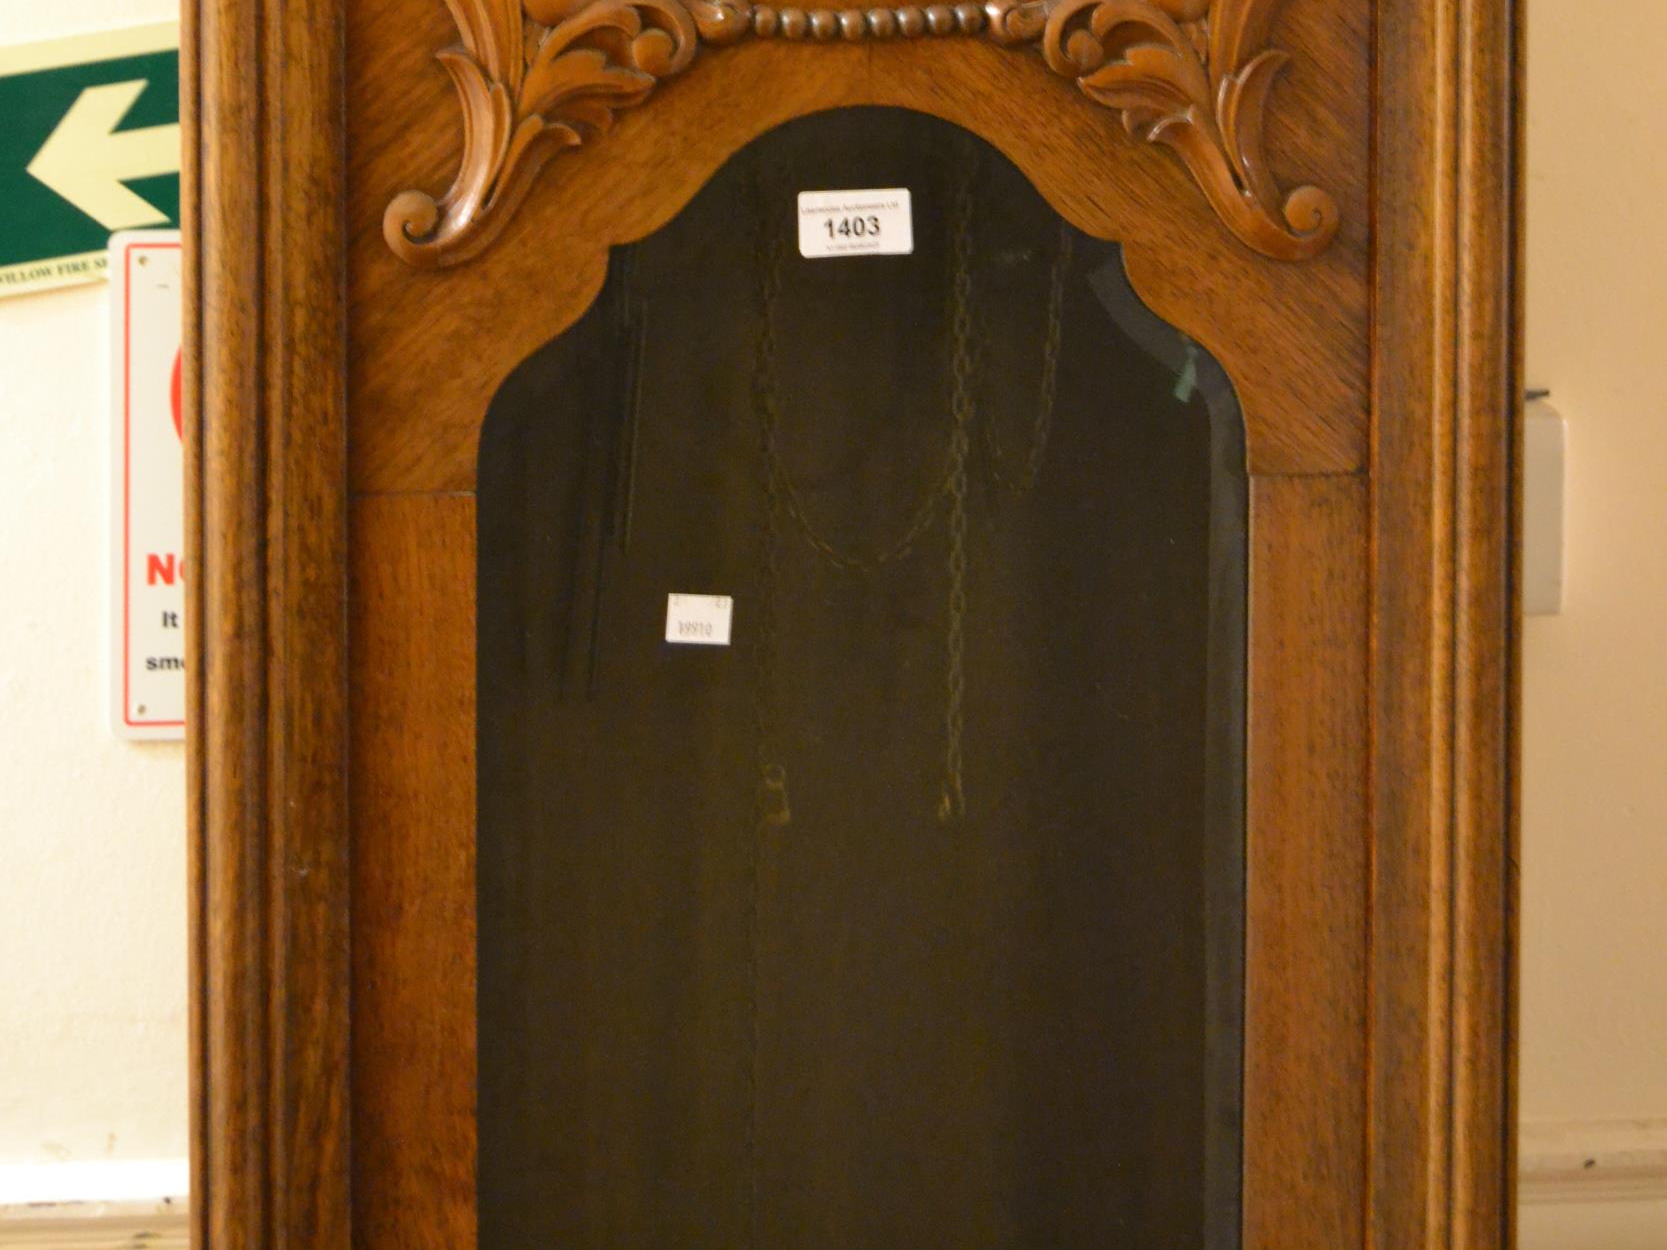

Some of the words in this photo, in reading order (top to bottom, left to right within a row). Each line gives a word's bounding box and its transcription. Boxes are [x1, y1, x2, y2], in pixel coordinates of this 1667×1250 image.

[823, 216, 880, 238] 1403
[57, 261, 88, 275] FIRE
[146, 553, 185, 586] N
[162, 611, 178, 629] It
